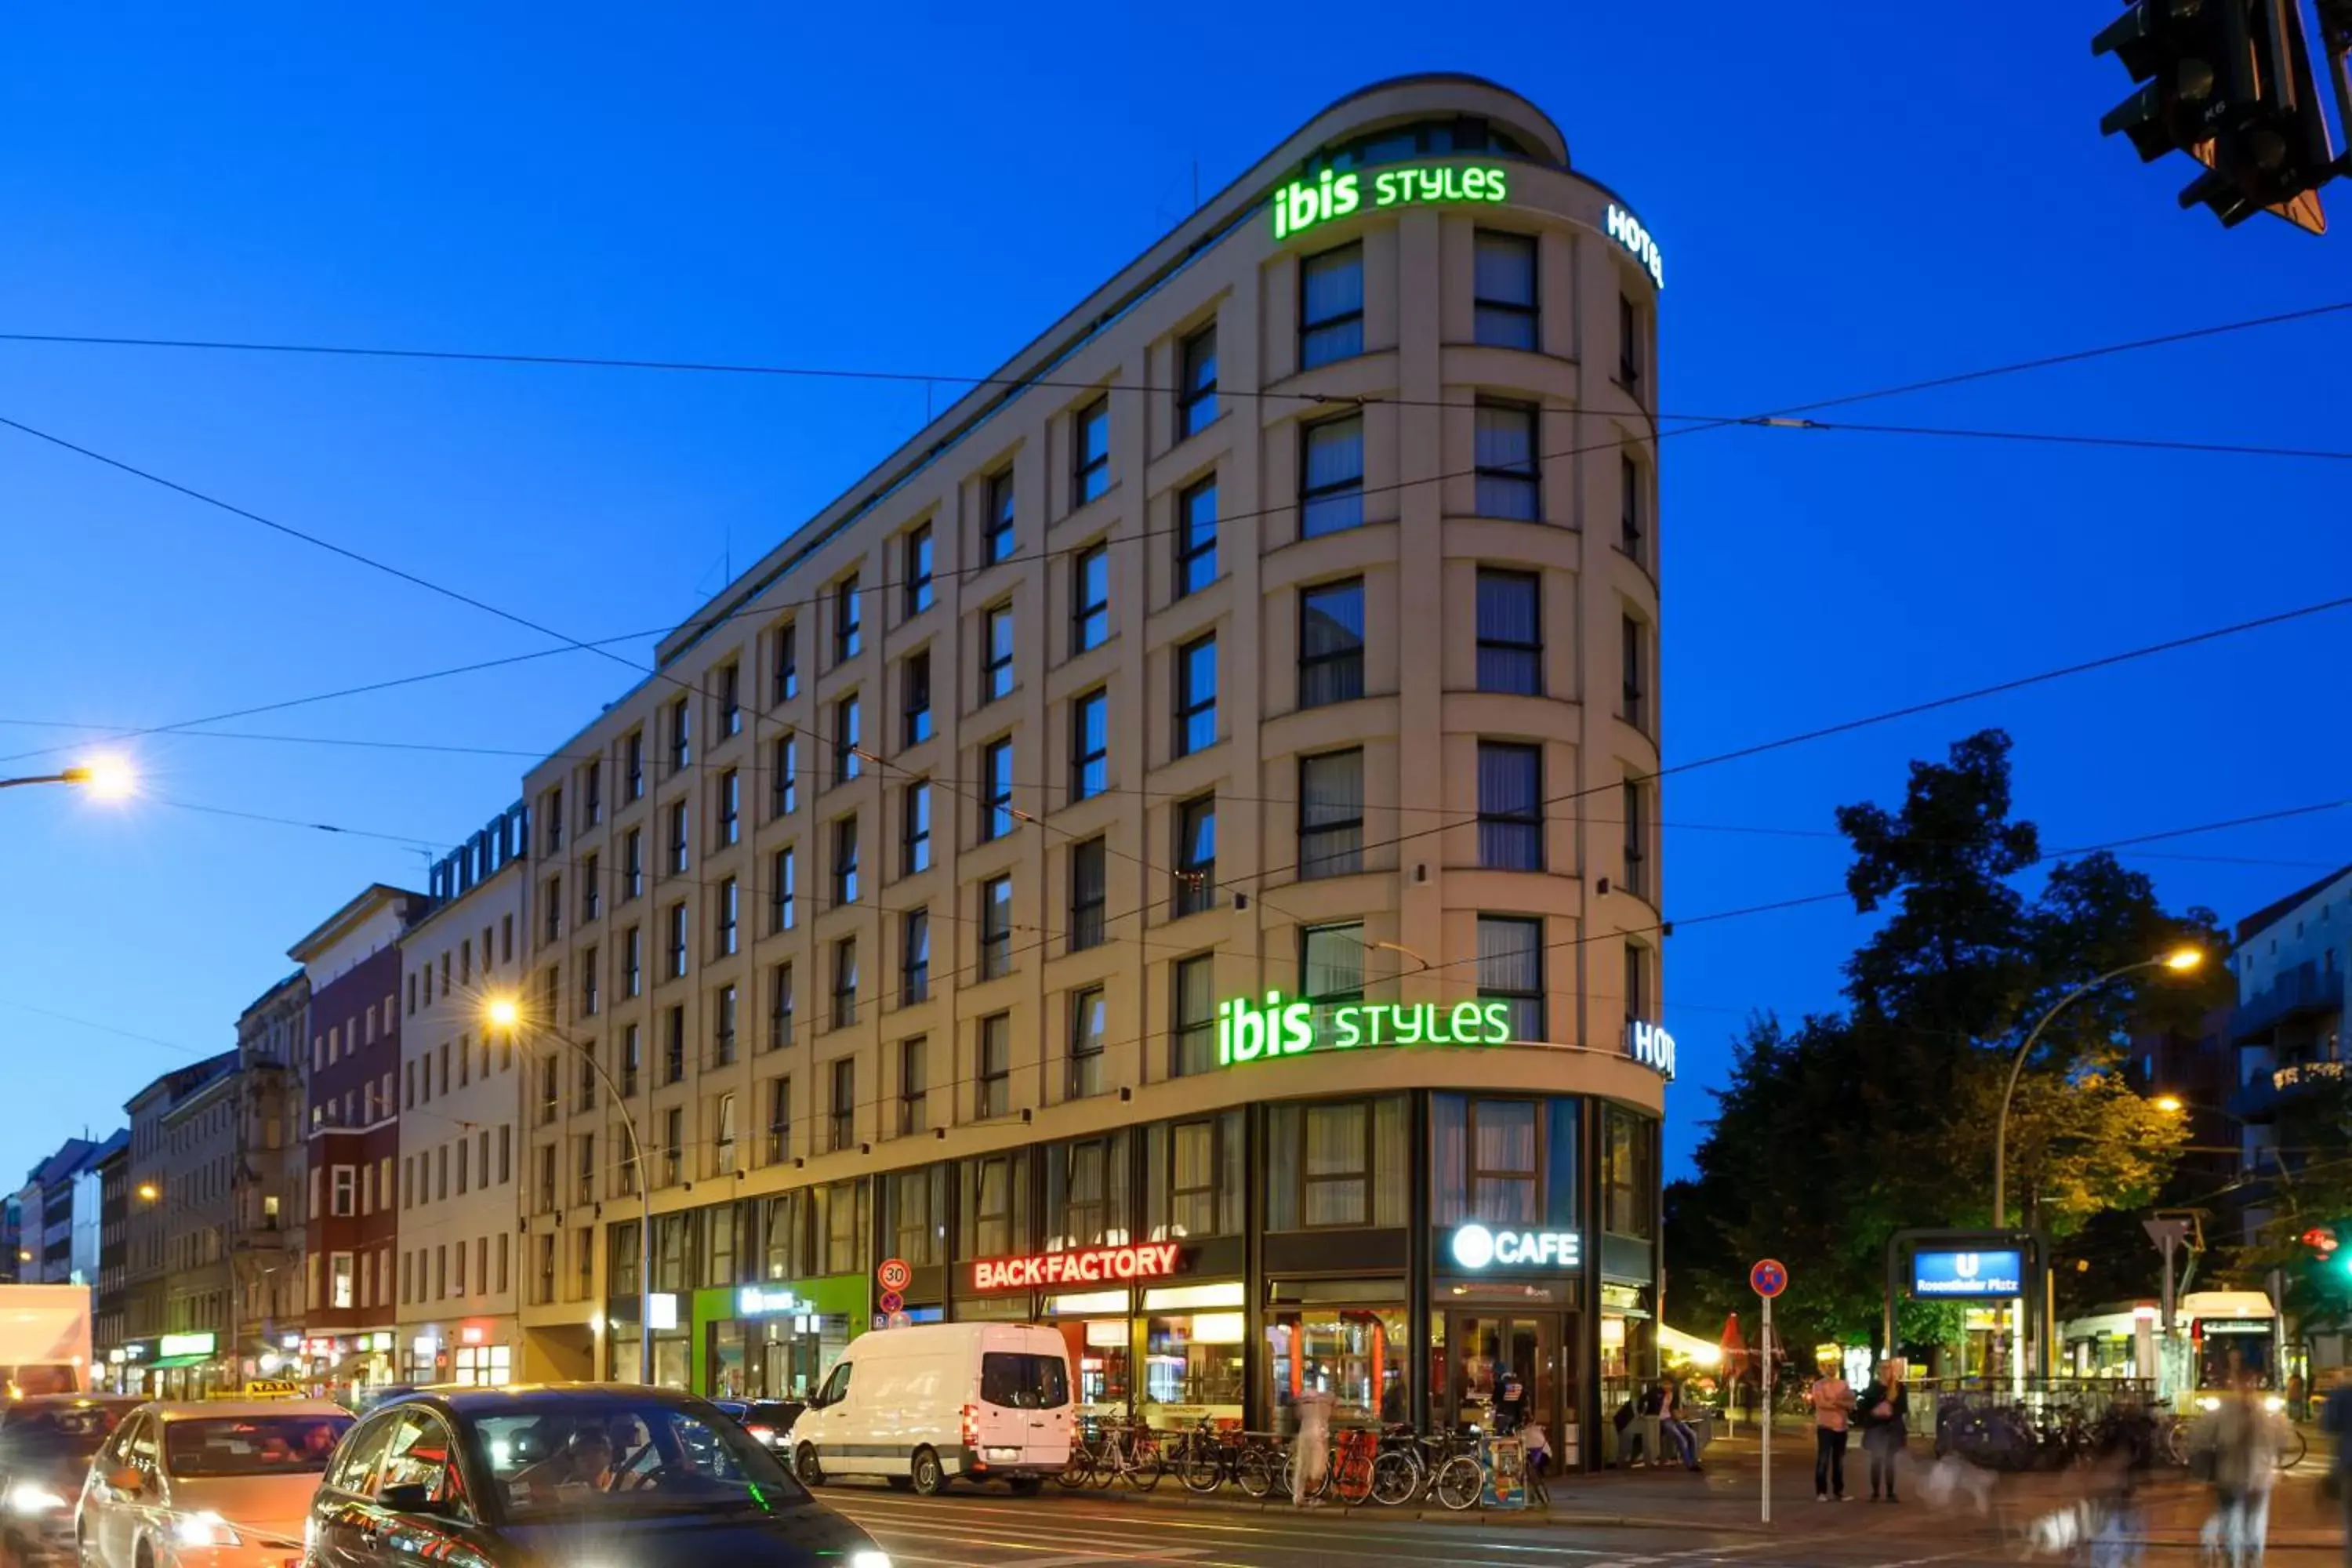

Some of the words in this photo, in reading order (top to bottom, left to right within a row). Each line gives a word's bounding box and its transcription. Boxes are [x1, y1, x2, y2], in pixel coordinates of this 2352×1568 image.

[1276, 170, 1358, 238] ibis
[1220, 991, 1312, 1065] ibis
[1495, 1231, 1579, 1265] CAFE
[886, 1268, 903, 1282] 30
[1956, 1254, 1979, 1278] U
[1987, 1277, 2019, 1291] Platz
